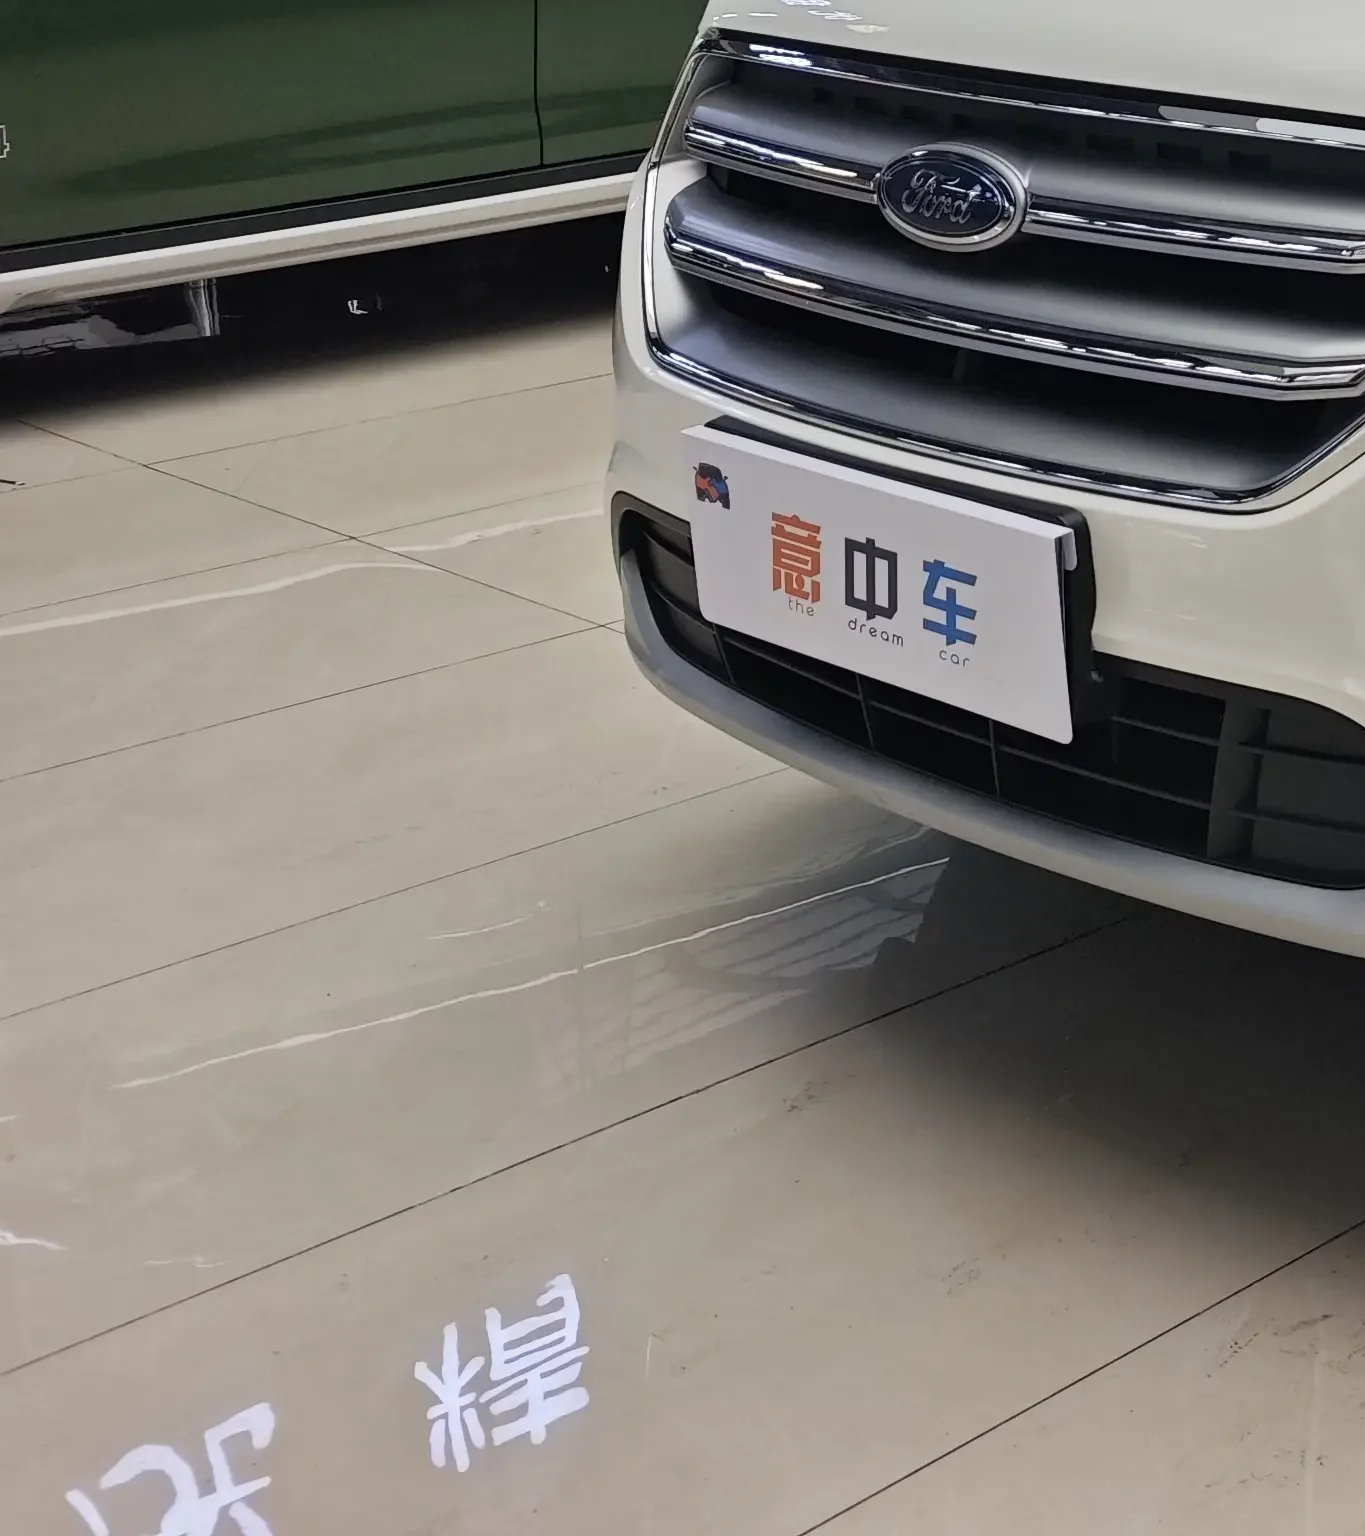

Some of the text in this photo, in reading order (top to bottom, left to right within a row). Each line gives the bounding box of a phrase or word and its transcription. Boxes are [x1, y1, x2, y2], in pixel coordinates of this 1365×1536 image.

[901, 168, 973, 224] Ford
[771, 513, 978, 646] 意中车
[788, 596, 971, 668] the dream car
